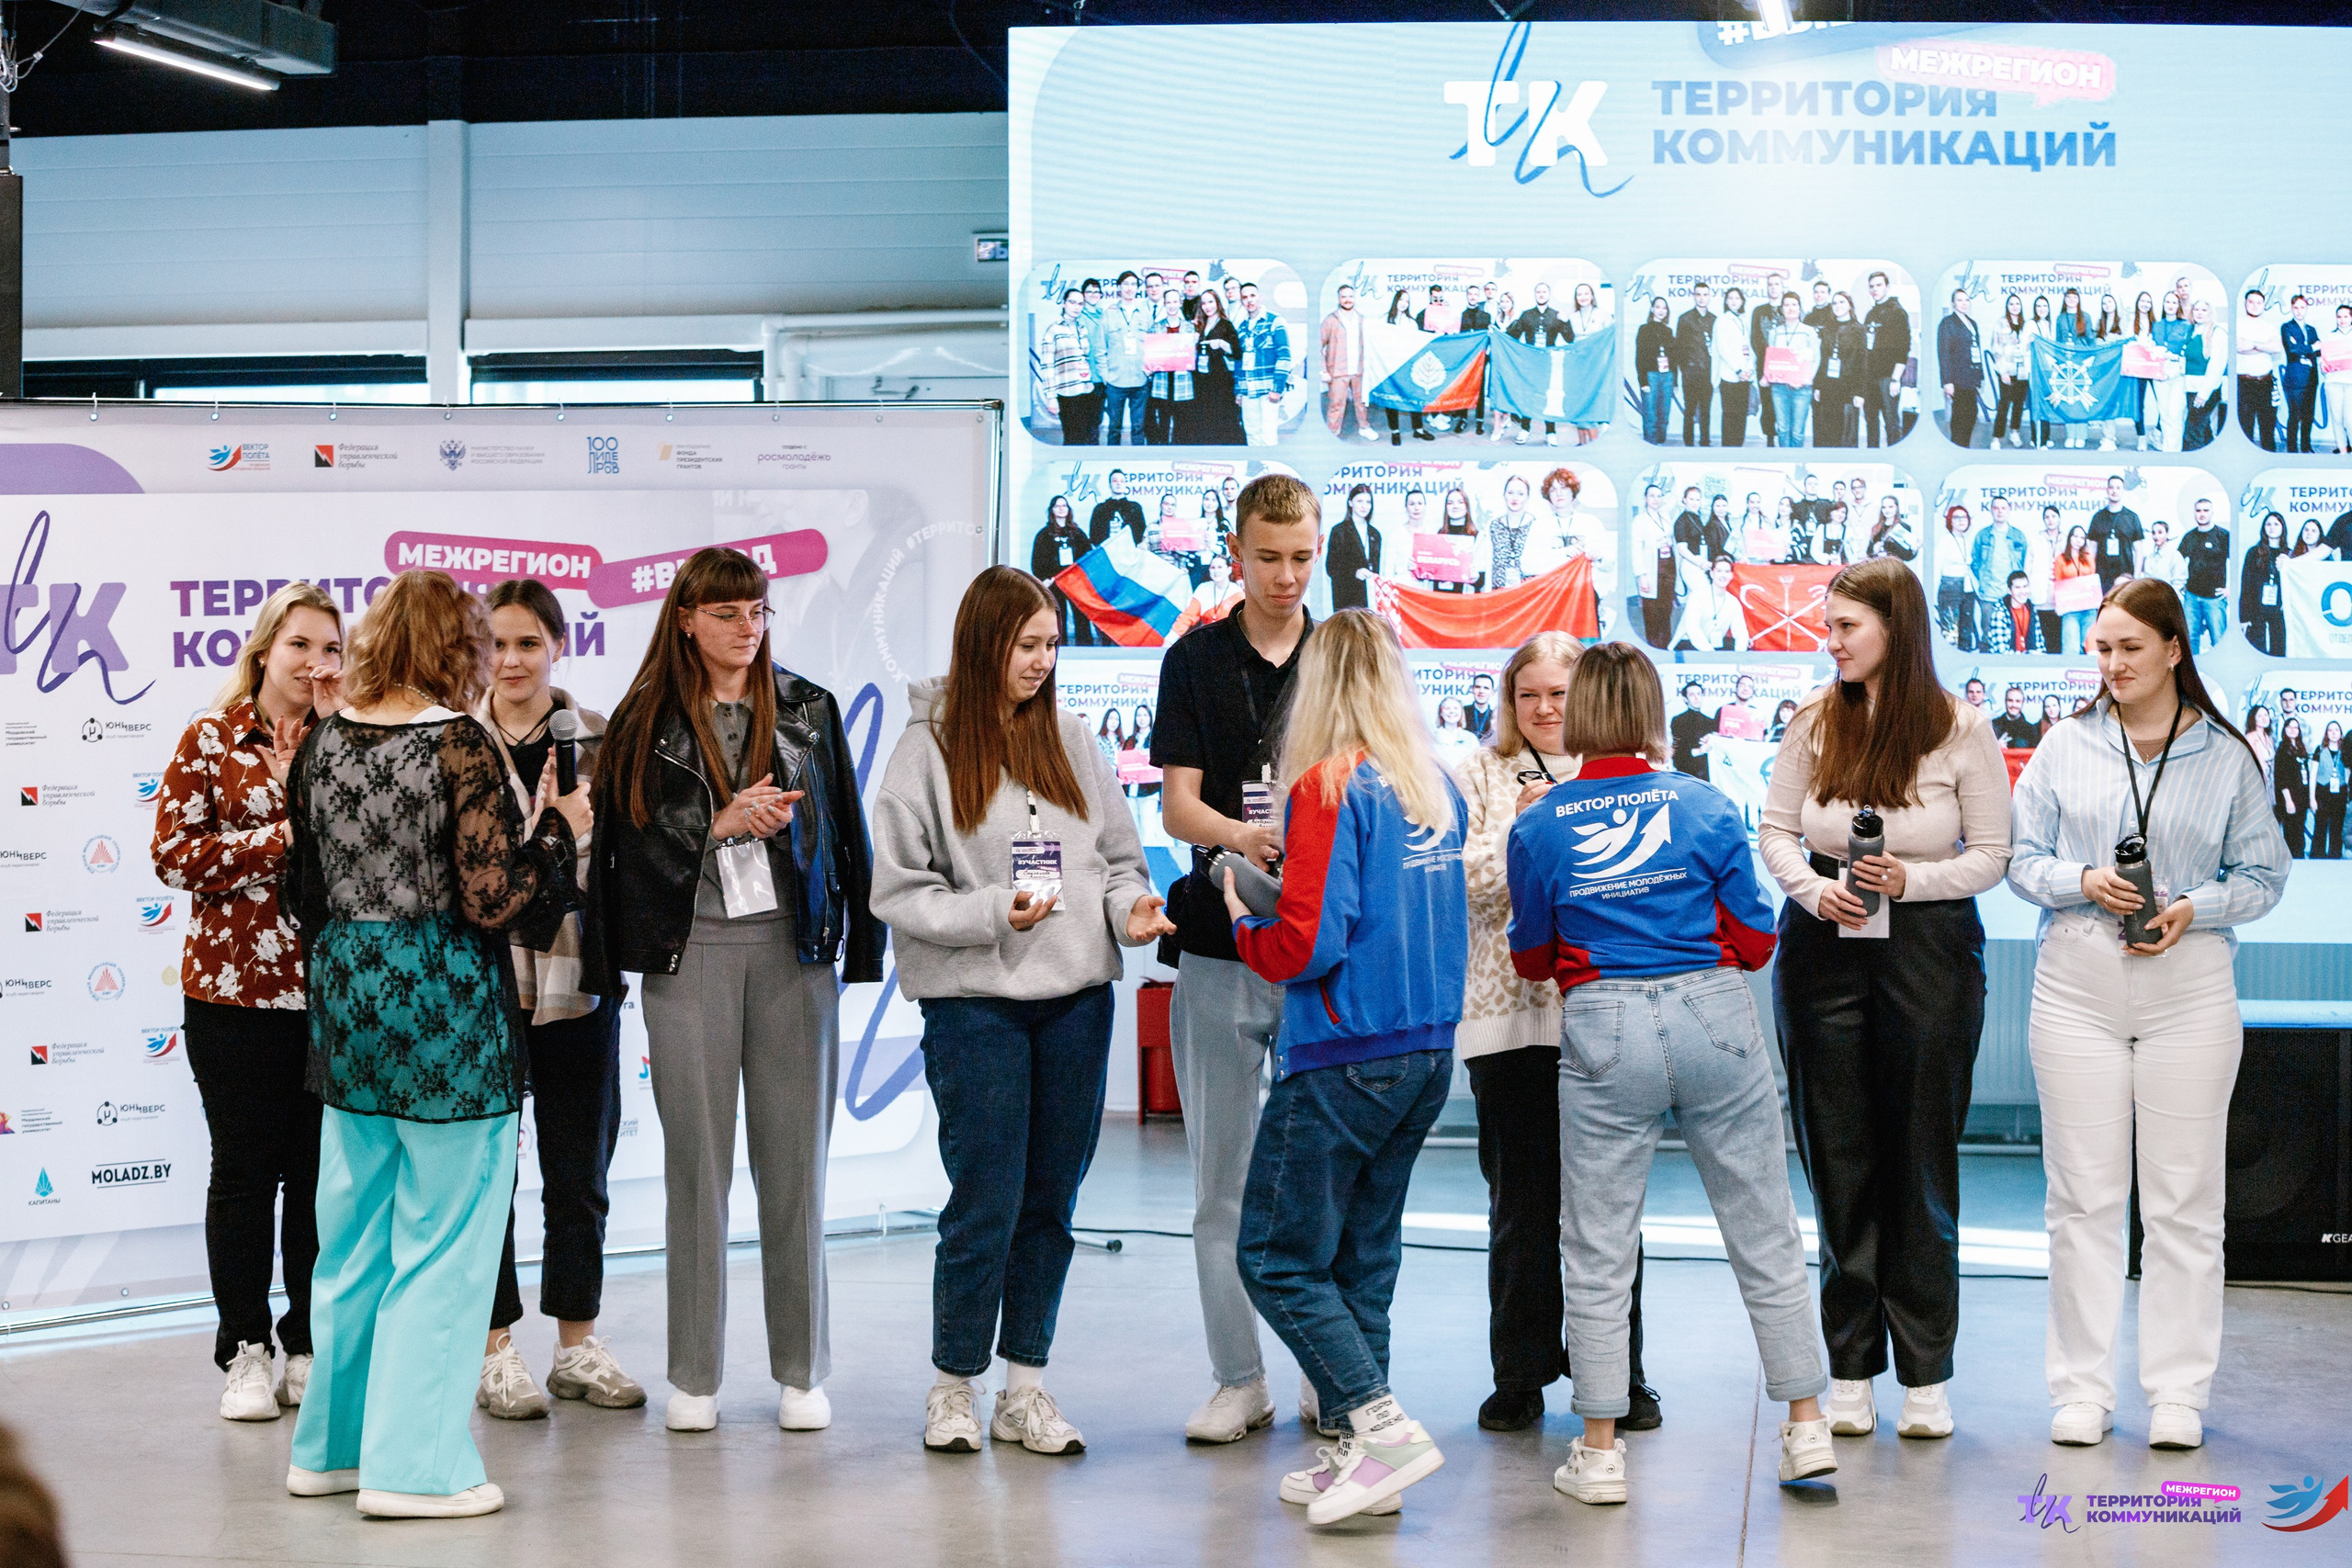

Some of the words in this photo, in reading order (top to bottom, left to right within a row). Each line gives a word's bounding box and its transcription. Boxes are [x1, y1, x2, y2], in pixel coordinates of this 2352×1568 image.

[1889, 47, 2102, 89] МЕЖРЕГИОН
[1652, 81, 1997, 118] ТЕРРИТОРИЯ
[1654, 121, 2117, 172] КОММУНИКАЦИЙ
[338, 443, 379, 452] Федерация
[587, 436, 618, 451] 100
[758, 452, 831, 465] росмолодёжь
[1124, 472, 1203, 482] ЕРРИТОРИЯ
[2290, 487, 2352, 498] ТЕРРИТ
[2290, 502, 2352, 513] КОММУ
[398, 542, 592, 579] МЕЖРЕГИОН
[1555, 796, 1616, 818] ВЕКТОР
[1618, 789, 1679, 808] ПОЛЁТА
[1569, 881, 1628, 898] ПРОДВИЖЕНИЕ
[1629, 872, 1688, 888] МОЛОДЁЖНЫХ
[1601, 886, 1650, 900] ИНИЦИАТИВ
[91, 1164, 172, 1184] MOLADZ.BY
[28, 1198, 61, 1206] КАПИТАНЫ
